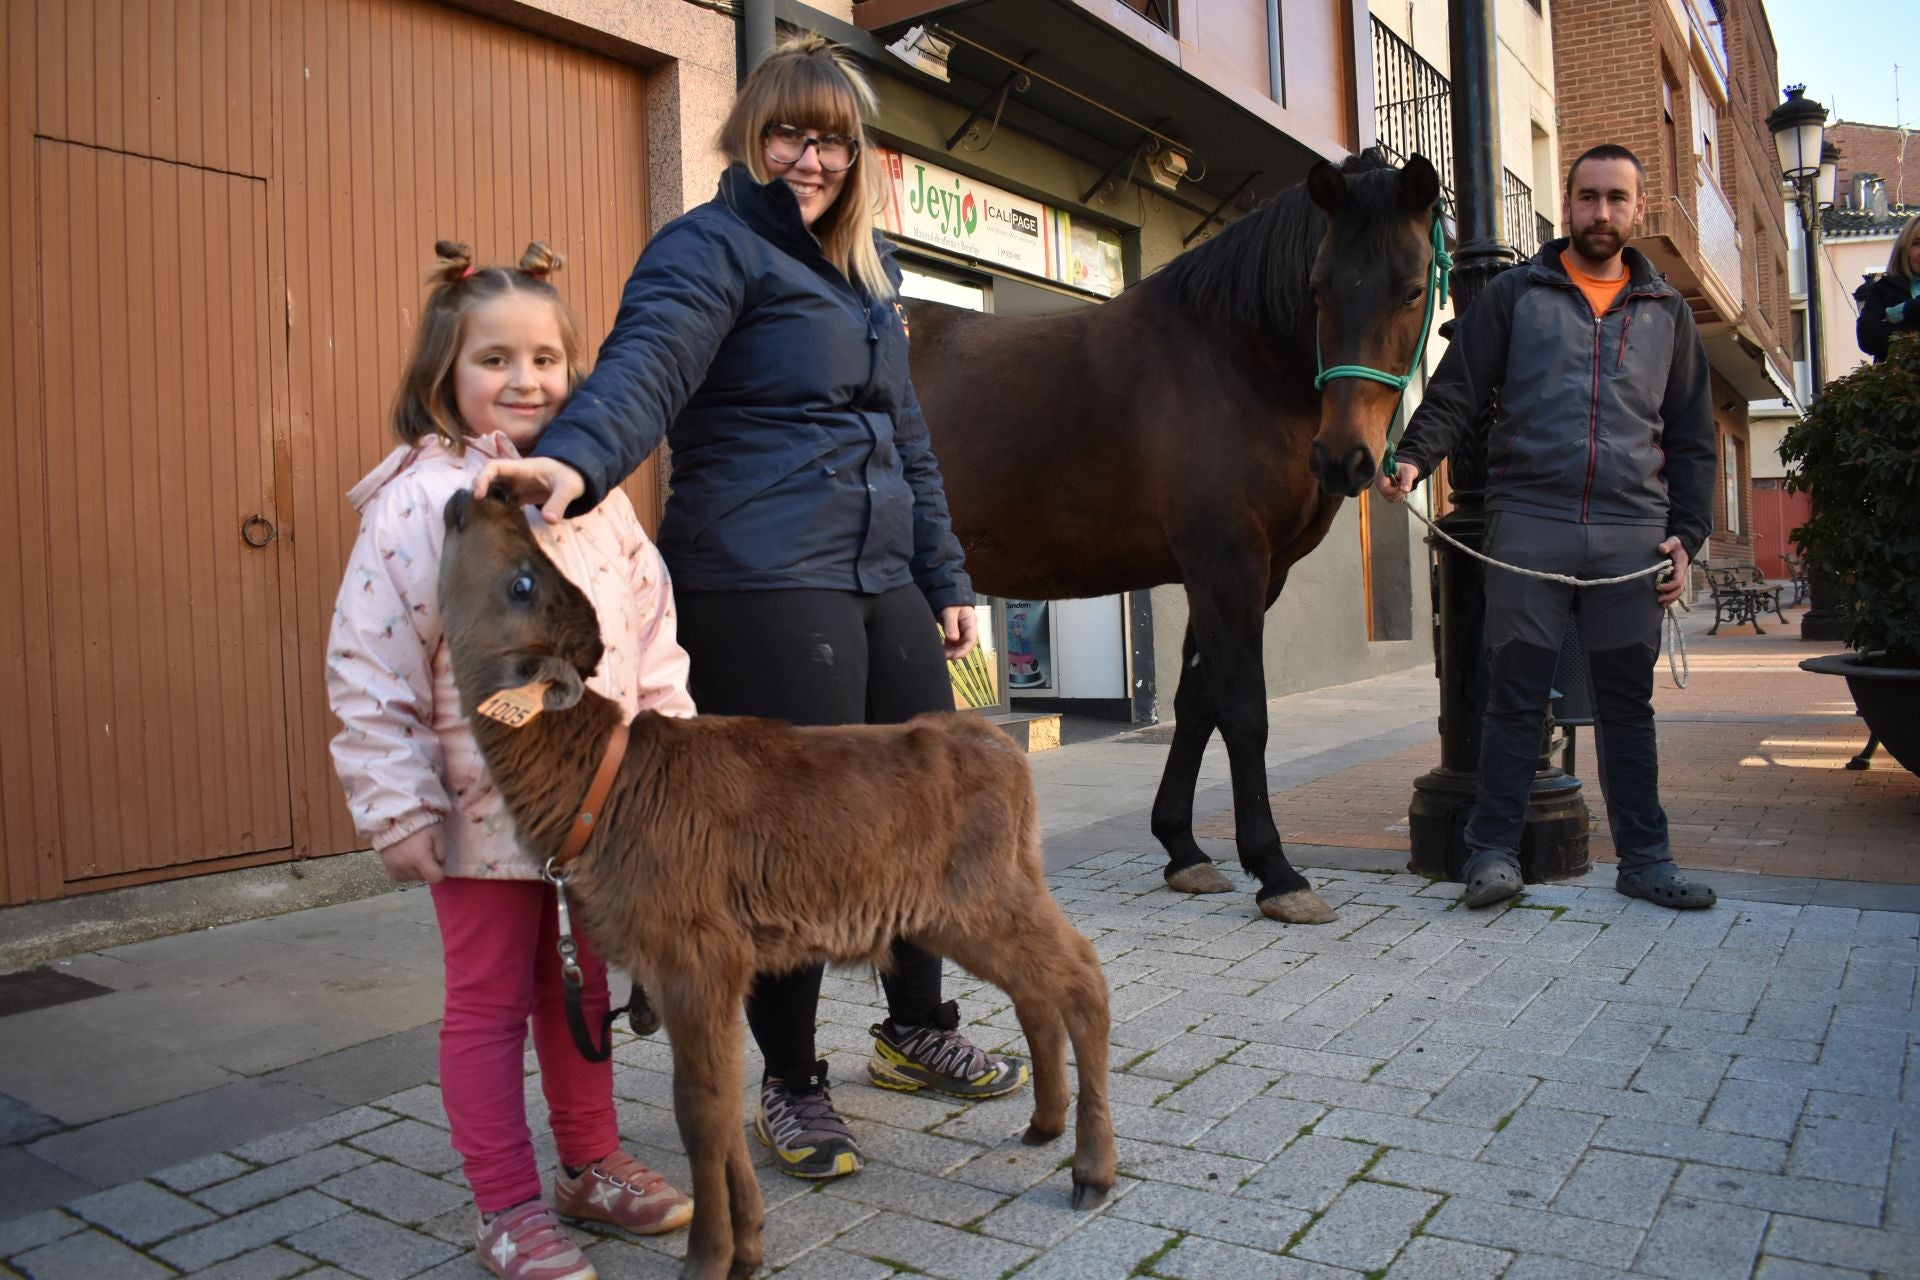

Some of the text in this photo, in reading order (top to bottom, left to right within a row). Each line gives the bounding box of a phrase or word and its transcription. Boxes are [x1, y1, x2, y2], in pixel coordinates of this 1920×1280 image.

[910, 164, 977, 238] Jeyjo
[988, 206, 1037, 232] CALIPAGE
[484, 699, 530, 724] 1005
[810, 1075, 818, 1085] S
